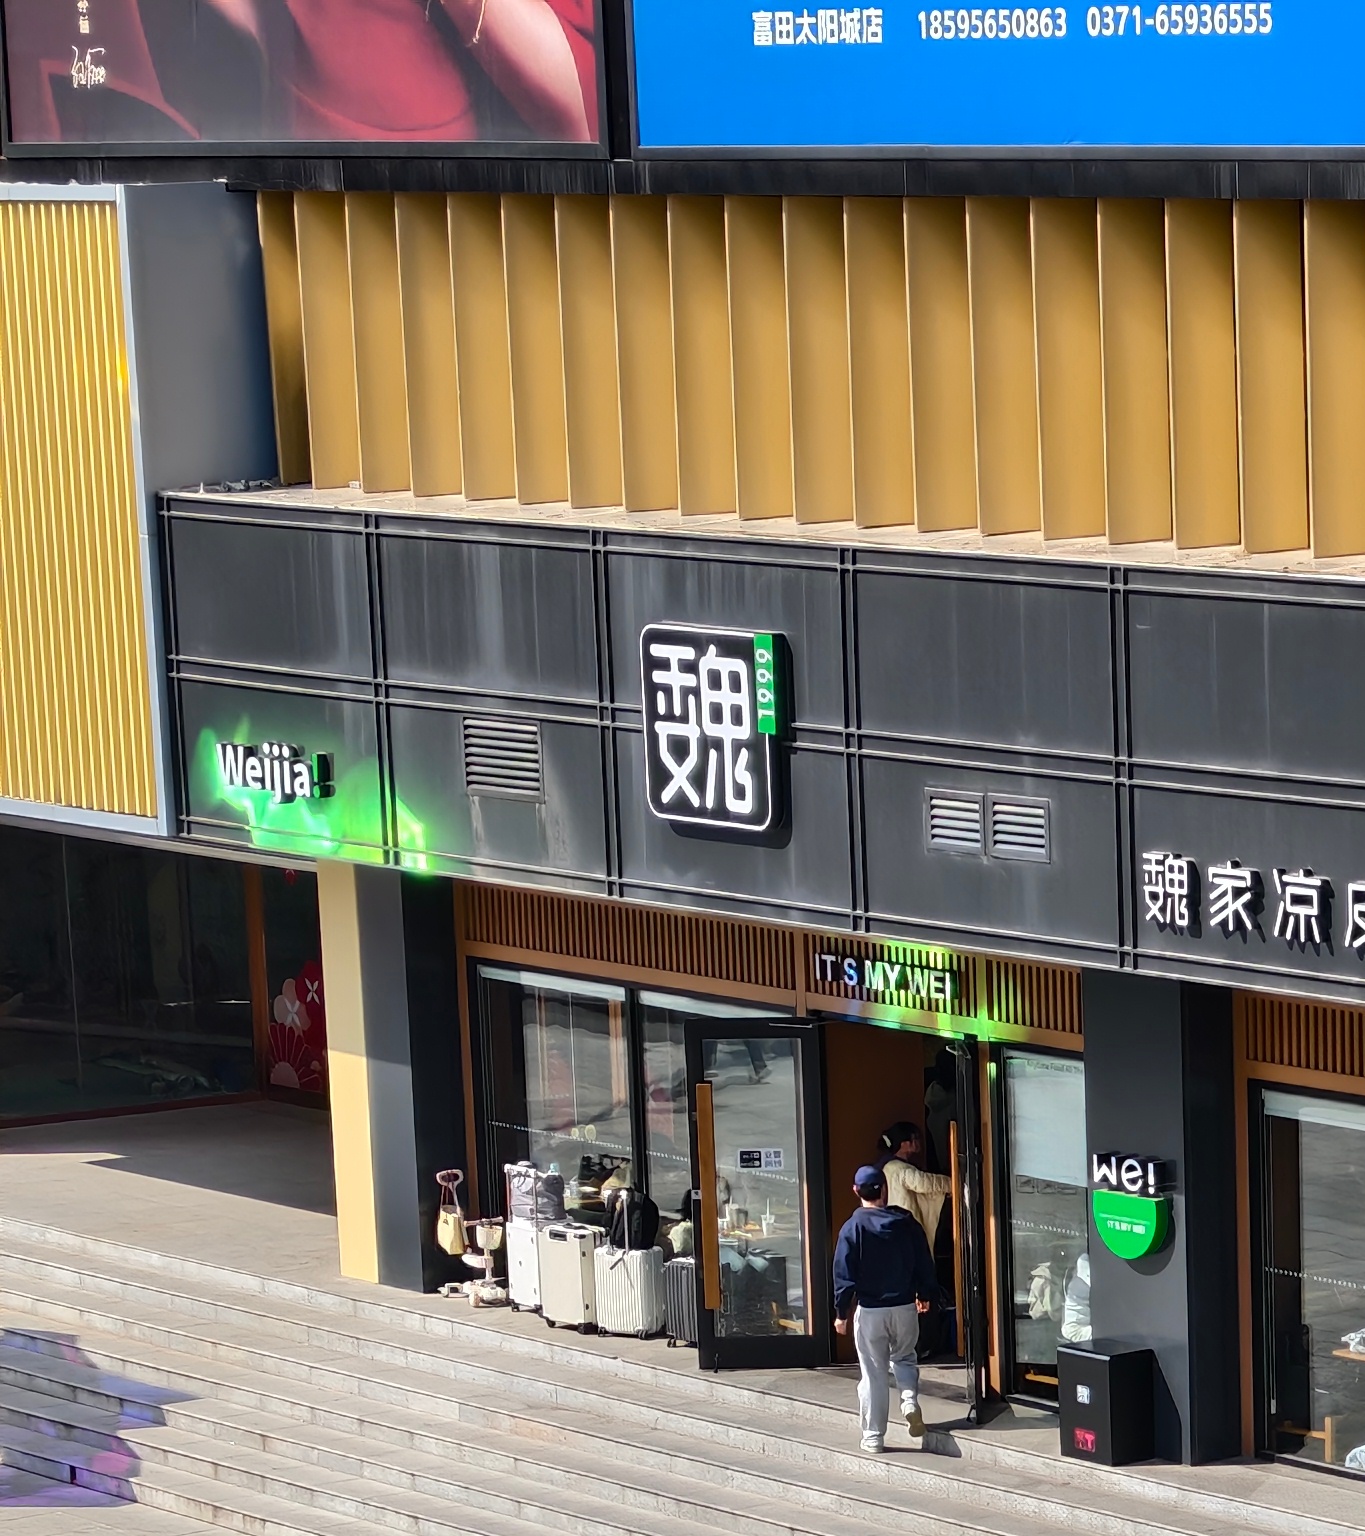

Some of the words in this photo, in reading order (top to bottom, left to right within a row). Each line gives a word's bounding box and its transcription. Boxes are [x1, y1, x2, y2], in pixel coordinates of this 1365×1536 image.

[751, 9, 883, 46] 富田太阳城店
[917, 6, 1067, 40] 18595650863
[1086, 2, 1273, 38] 0371-65936555
[650, 643, 753, 814] 魏
[215, 742, 321, 804] Weijia!
[815, 952, 859, 986] IT'S
[864, 959, 901, 992] MY
[905, 966, 951, 1001] WEI
